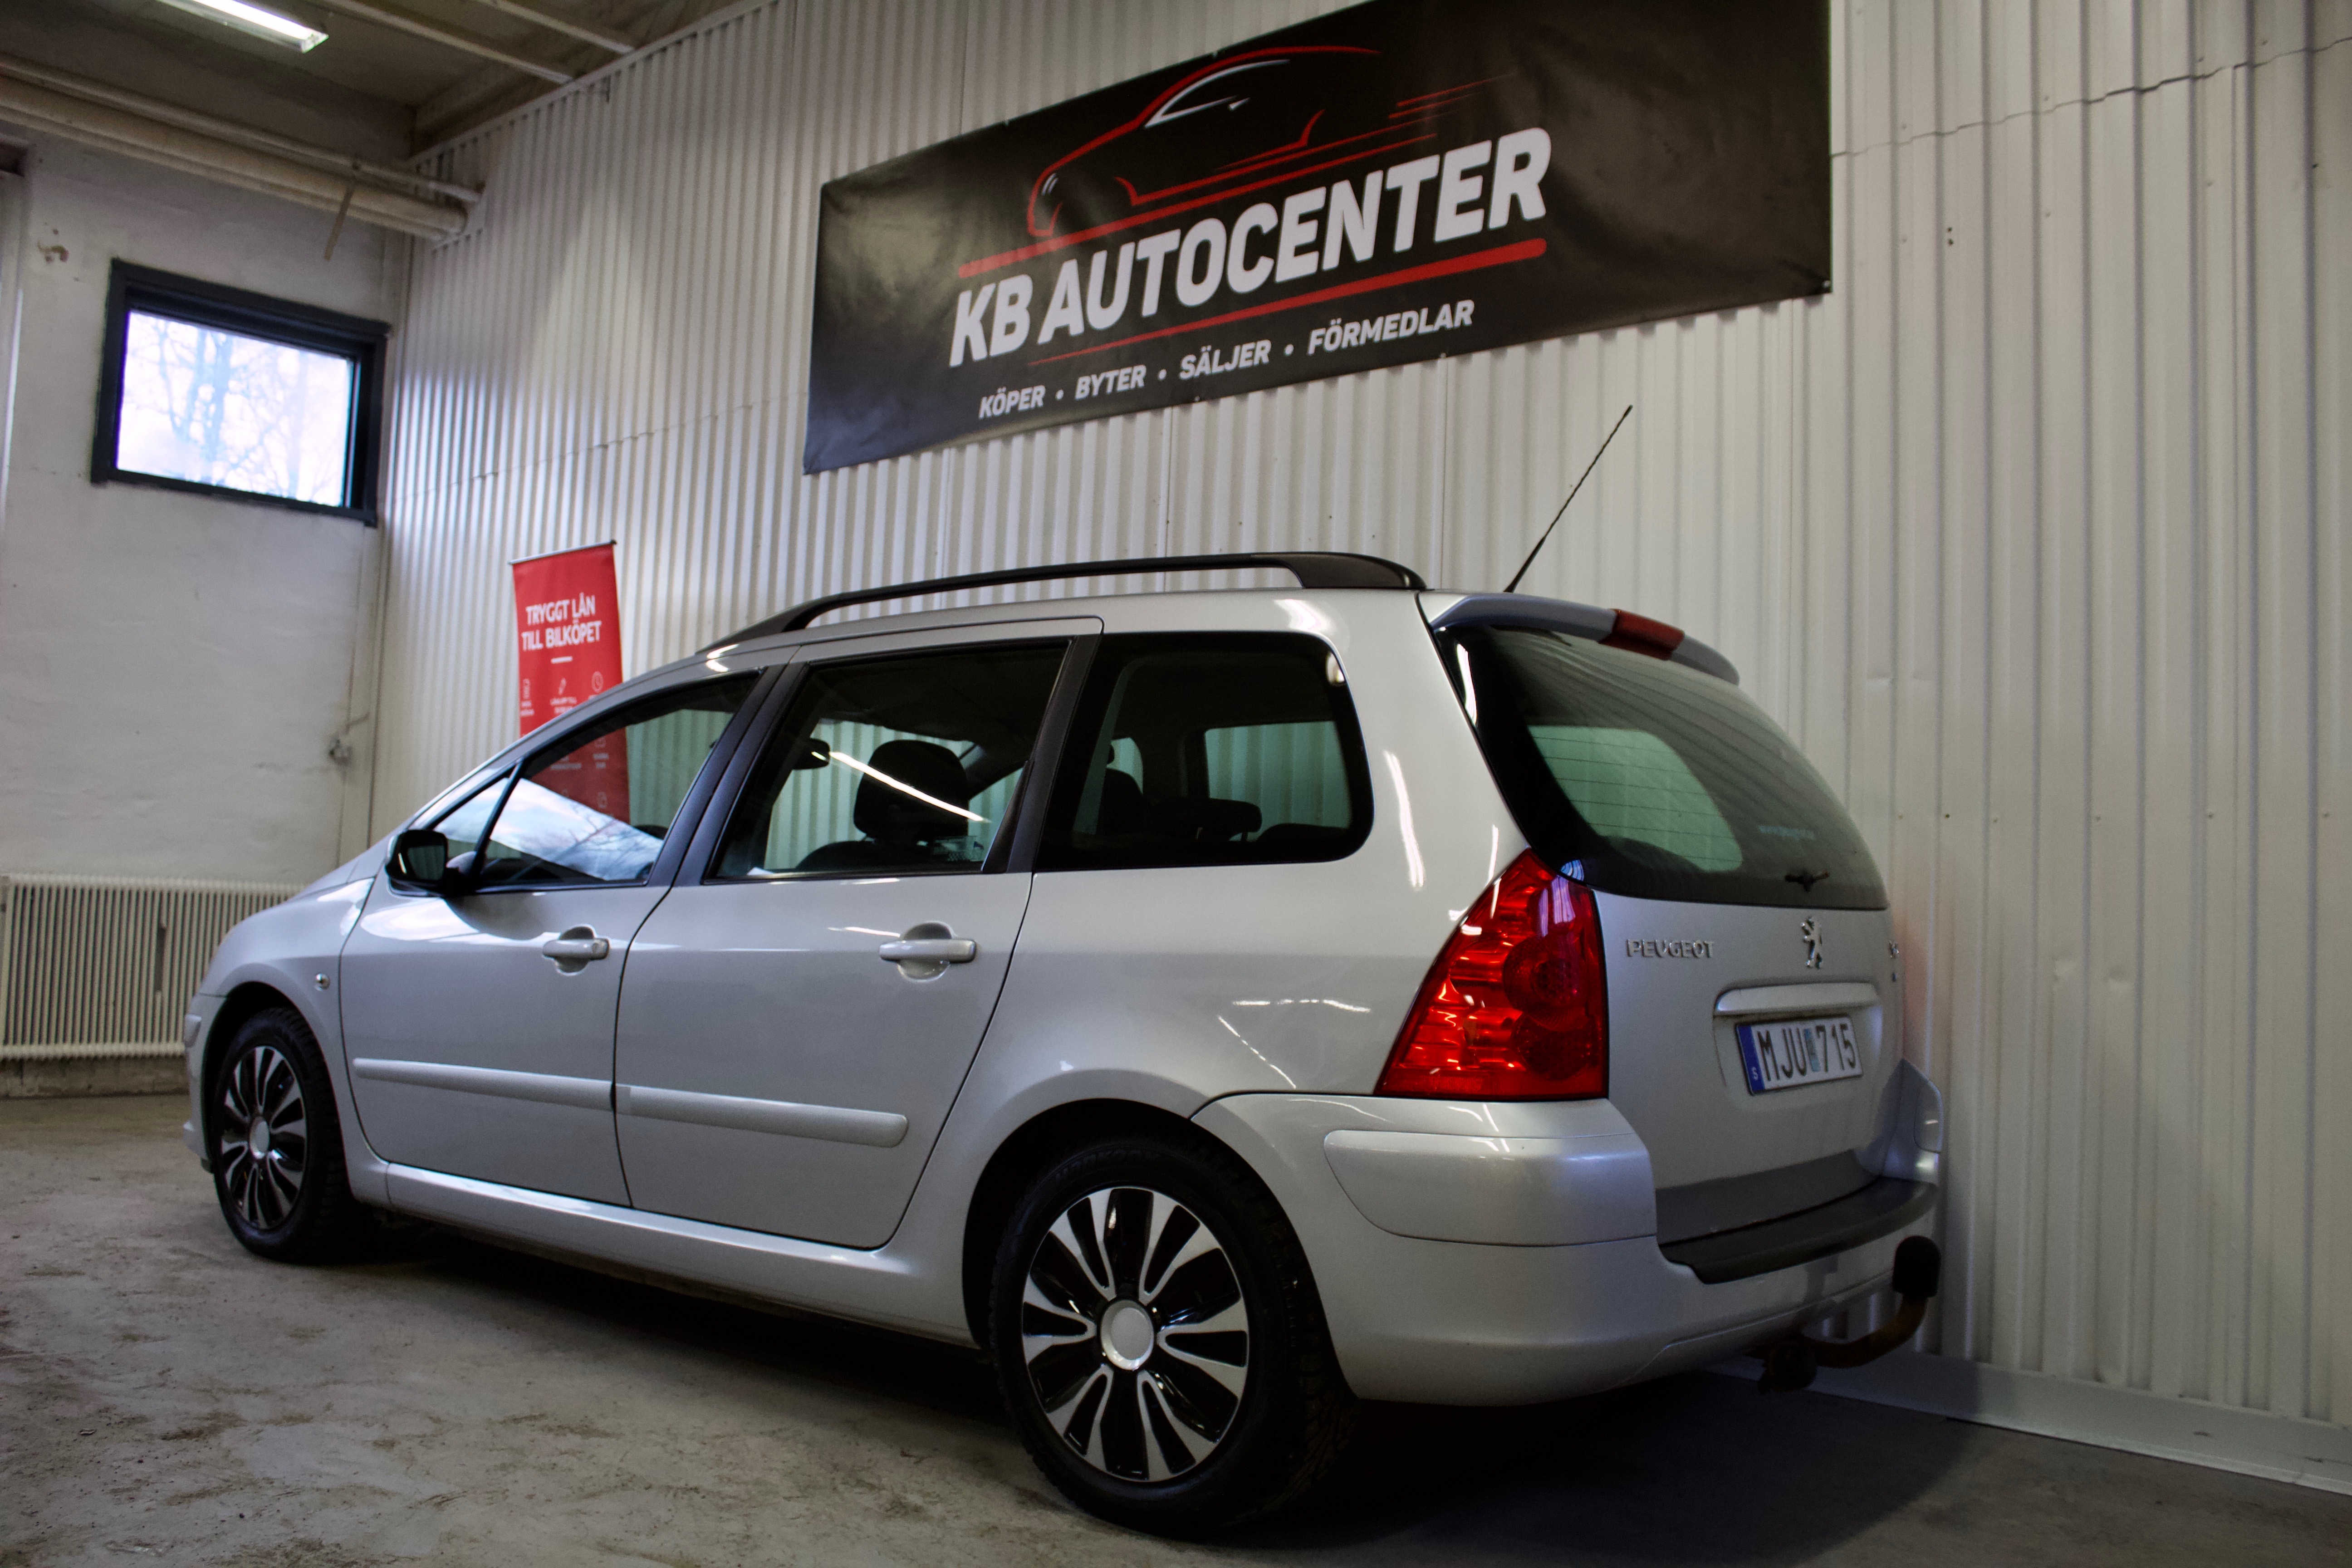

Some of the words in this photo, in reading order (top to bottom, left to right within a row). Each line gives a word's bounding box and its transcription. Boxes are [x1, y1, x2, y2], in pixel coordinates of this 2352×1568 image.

[949, 274, 1033, 368] KB
[1037, 127, 1552, 345] AUTOCENTER
[978, 387, 1046, 420] KÖPER
[1075, 364, 1147, 399] BYTER
[1179, 339, 1272, 380] SÄLJER
[1307, 299, 1475, 355] FÖRMEDLAR
[525, 599, 570, 627] TRYGGT
[572, 591, 596, 618] LÅN
[521, 629, 544, 652] TILL
[545, 618, 603, 649] BILKÖPET
[1626, 938, 1714, 959] PEUGEOT
[1756, 1028, 1808, 1082] MJU
[1815, 1022, 1857, 1074] 715
